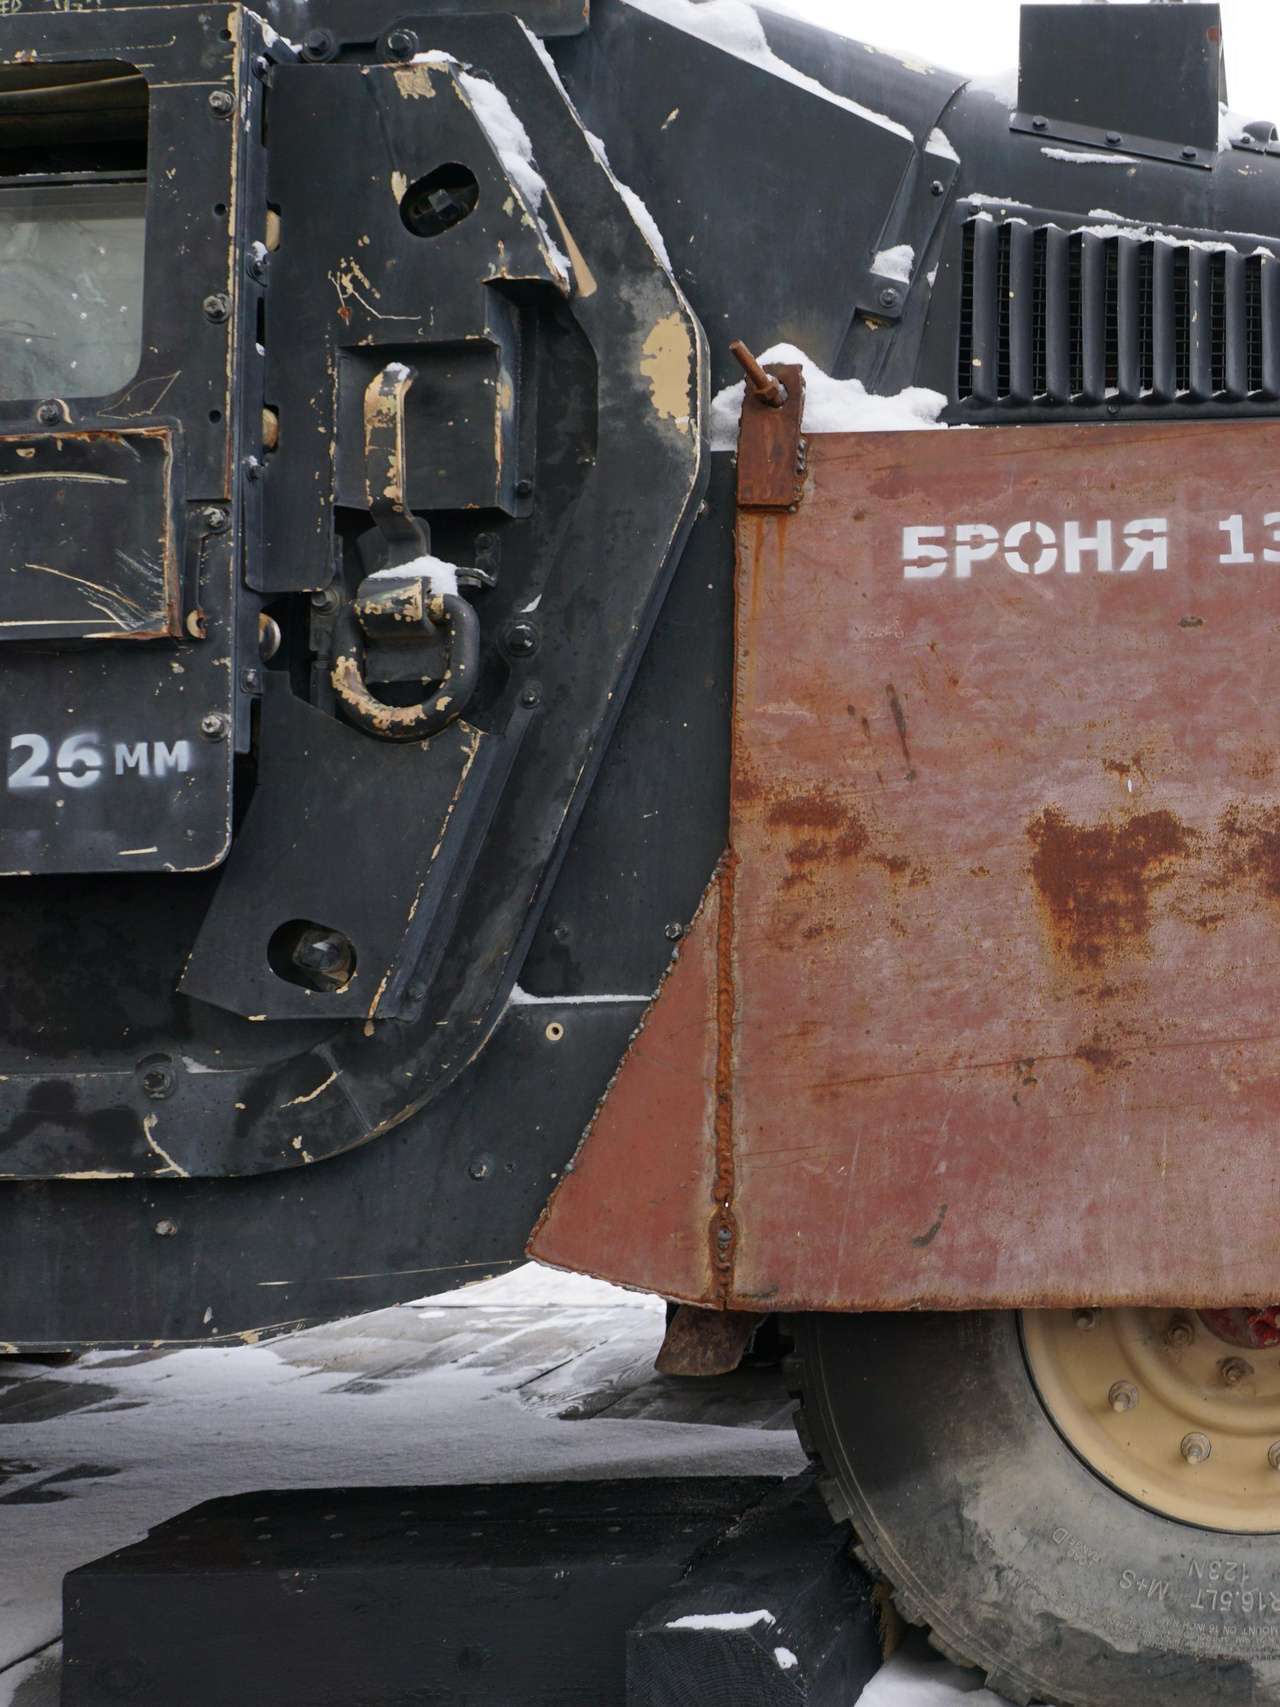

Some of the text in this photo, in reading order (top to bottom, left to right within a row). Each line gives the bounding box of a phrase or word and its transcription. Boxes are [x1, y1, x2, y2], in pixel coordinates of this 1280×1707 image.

[902, 517, 1169, 579] БРОНЯ
[7, 732, 103, 789] 26
[1051, 1527, 1102, 1562] RANGE D
[1066, 1548, 1093, 1570] LOAD
[1187, 1558, 1250, 1584] 123N
